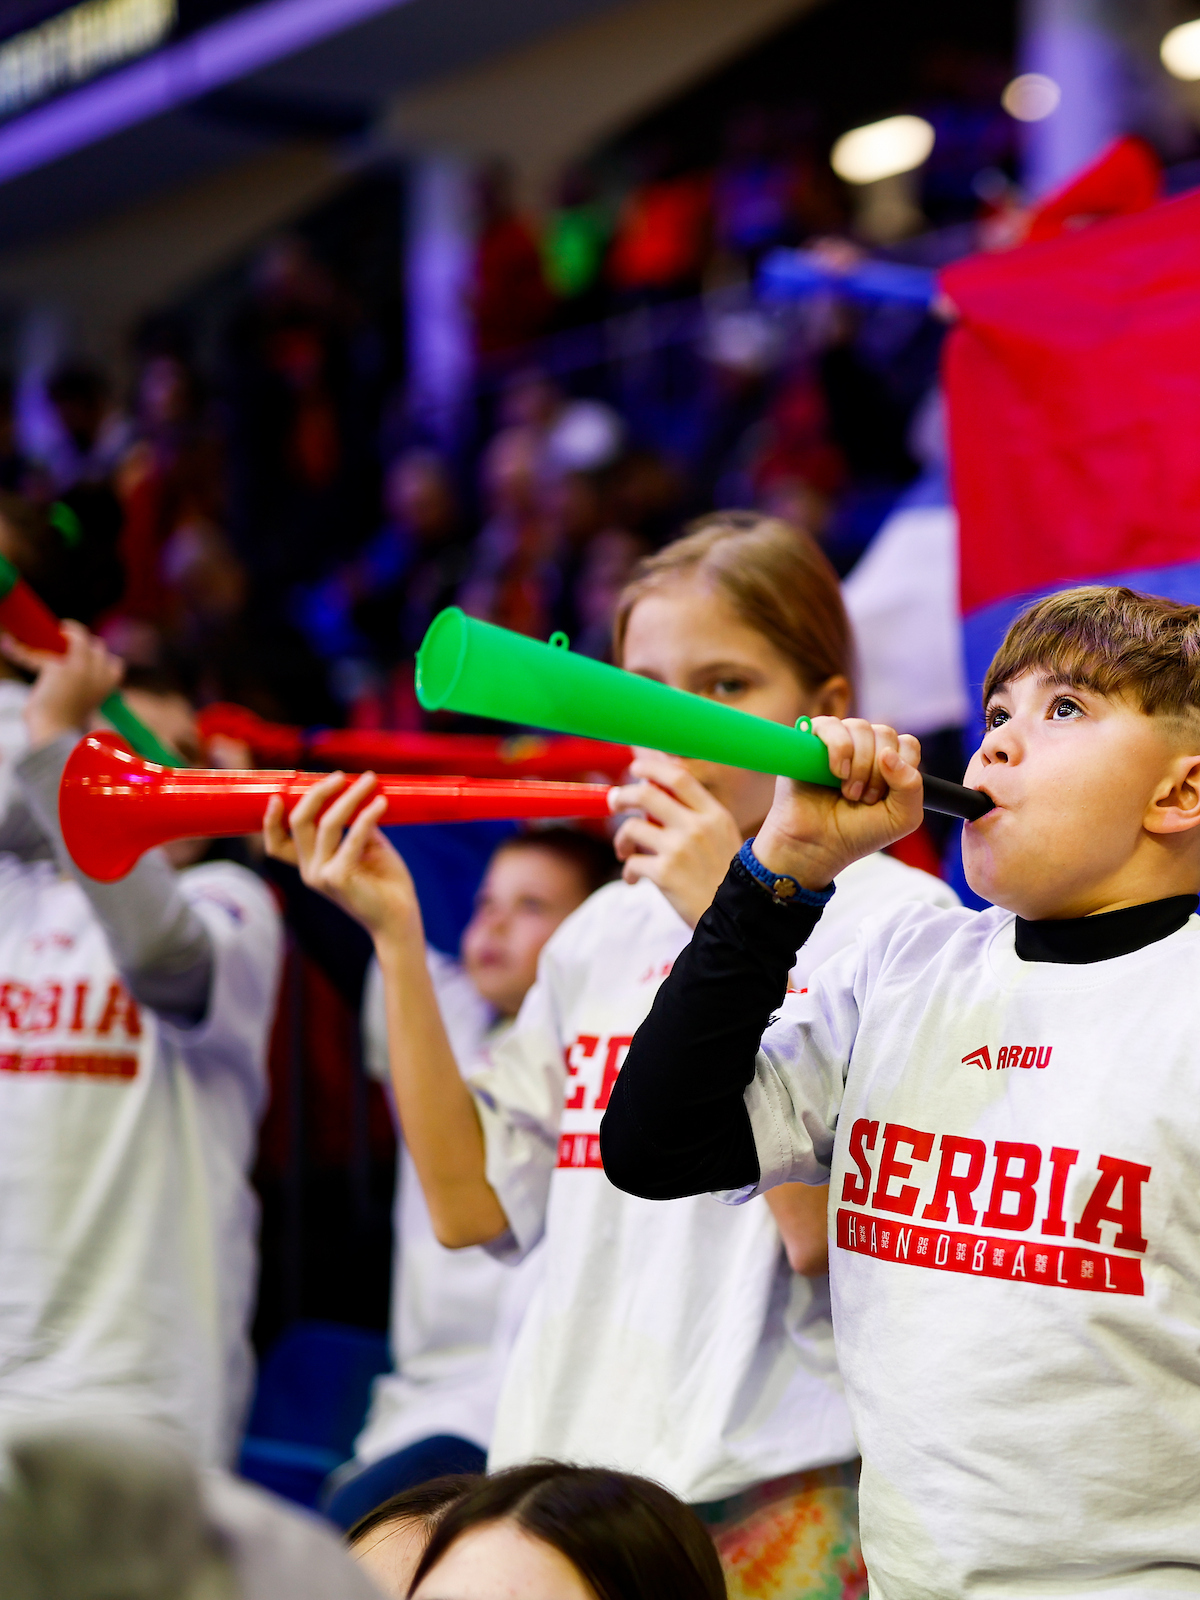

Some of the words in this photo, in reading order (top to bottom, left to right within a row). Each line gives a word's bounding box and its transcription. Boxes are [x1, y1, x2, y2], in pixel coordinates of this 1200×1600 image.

[996, 1045, 1053, 1070] ARDU
[841, 1118, 1152, 1254] SERBIA
[847, 1215, 1118, 1290] HANDBALL
